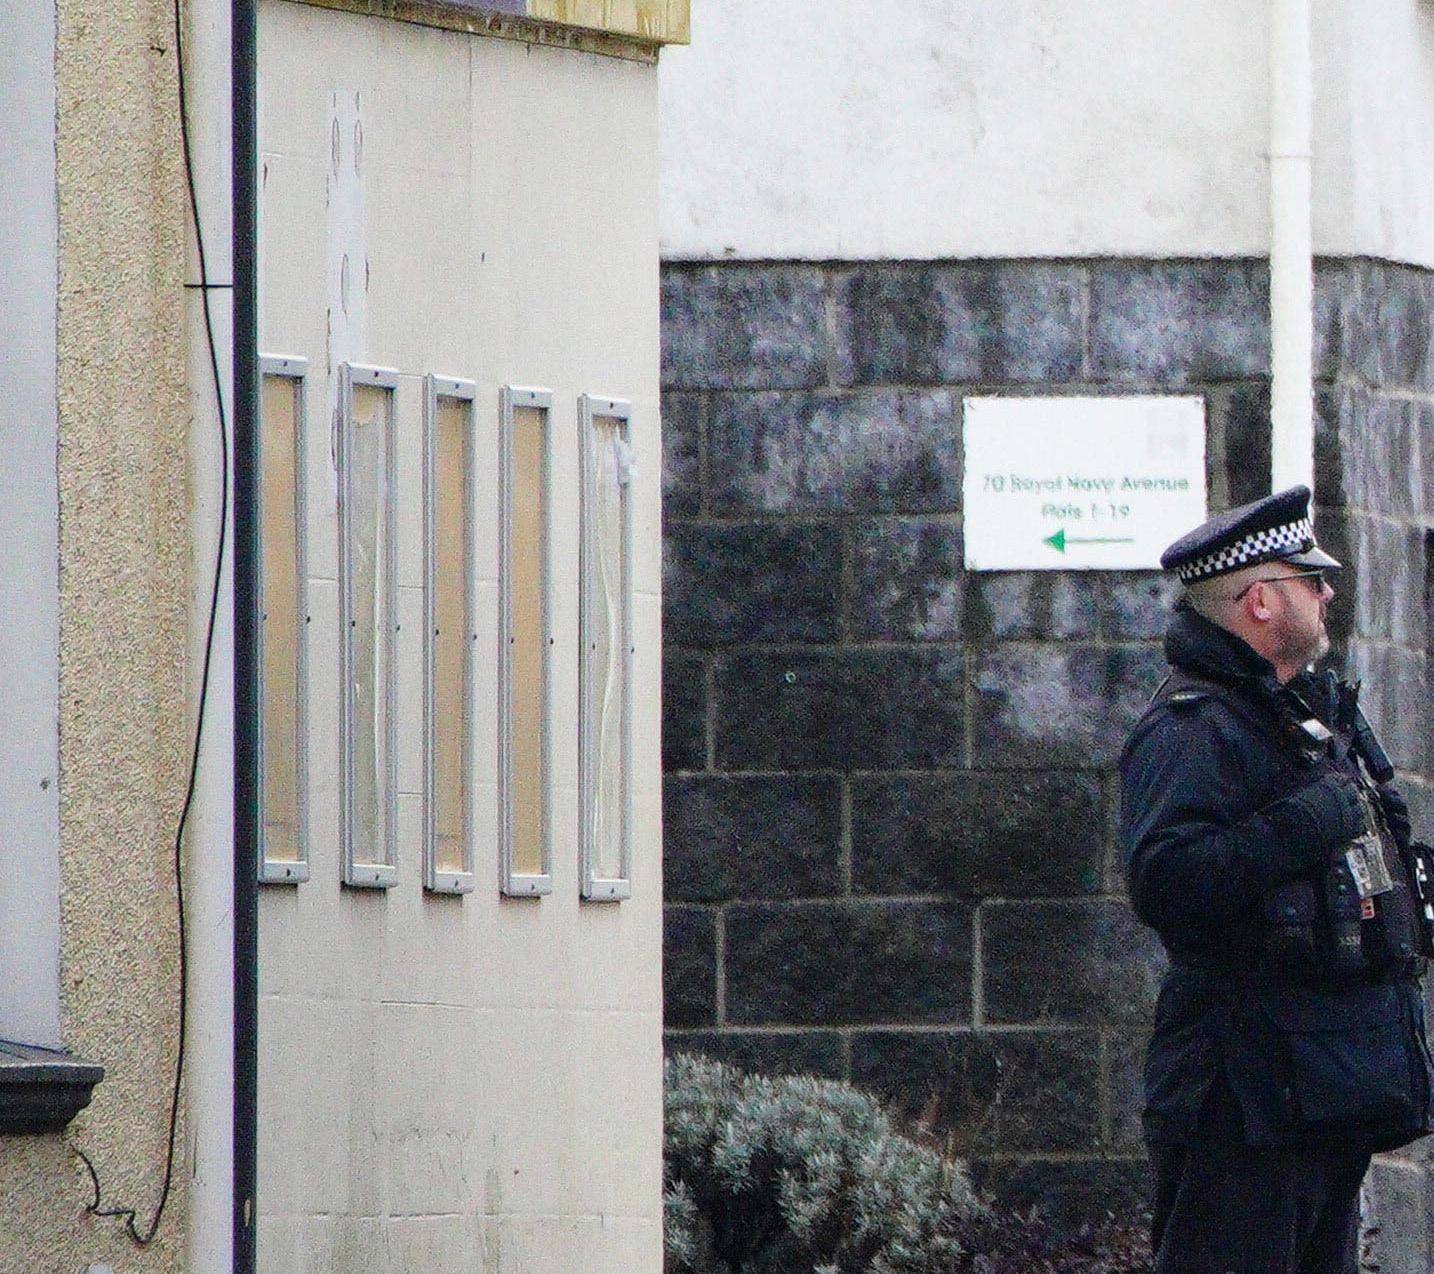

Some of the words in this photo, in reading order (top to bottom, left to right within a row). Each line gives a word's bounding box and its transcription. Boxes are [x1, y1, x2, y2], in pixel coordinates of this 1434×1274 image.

[1010, 474, 1062, 495] Royal
[1067, 475, 1115, 494] Navy
[1120, 476, 1190, 491] Avenue
